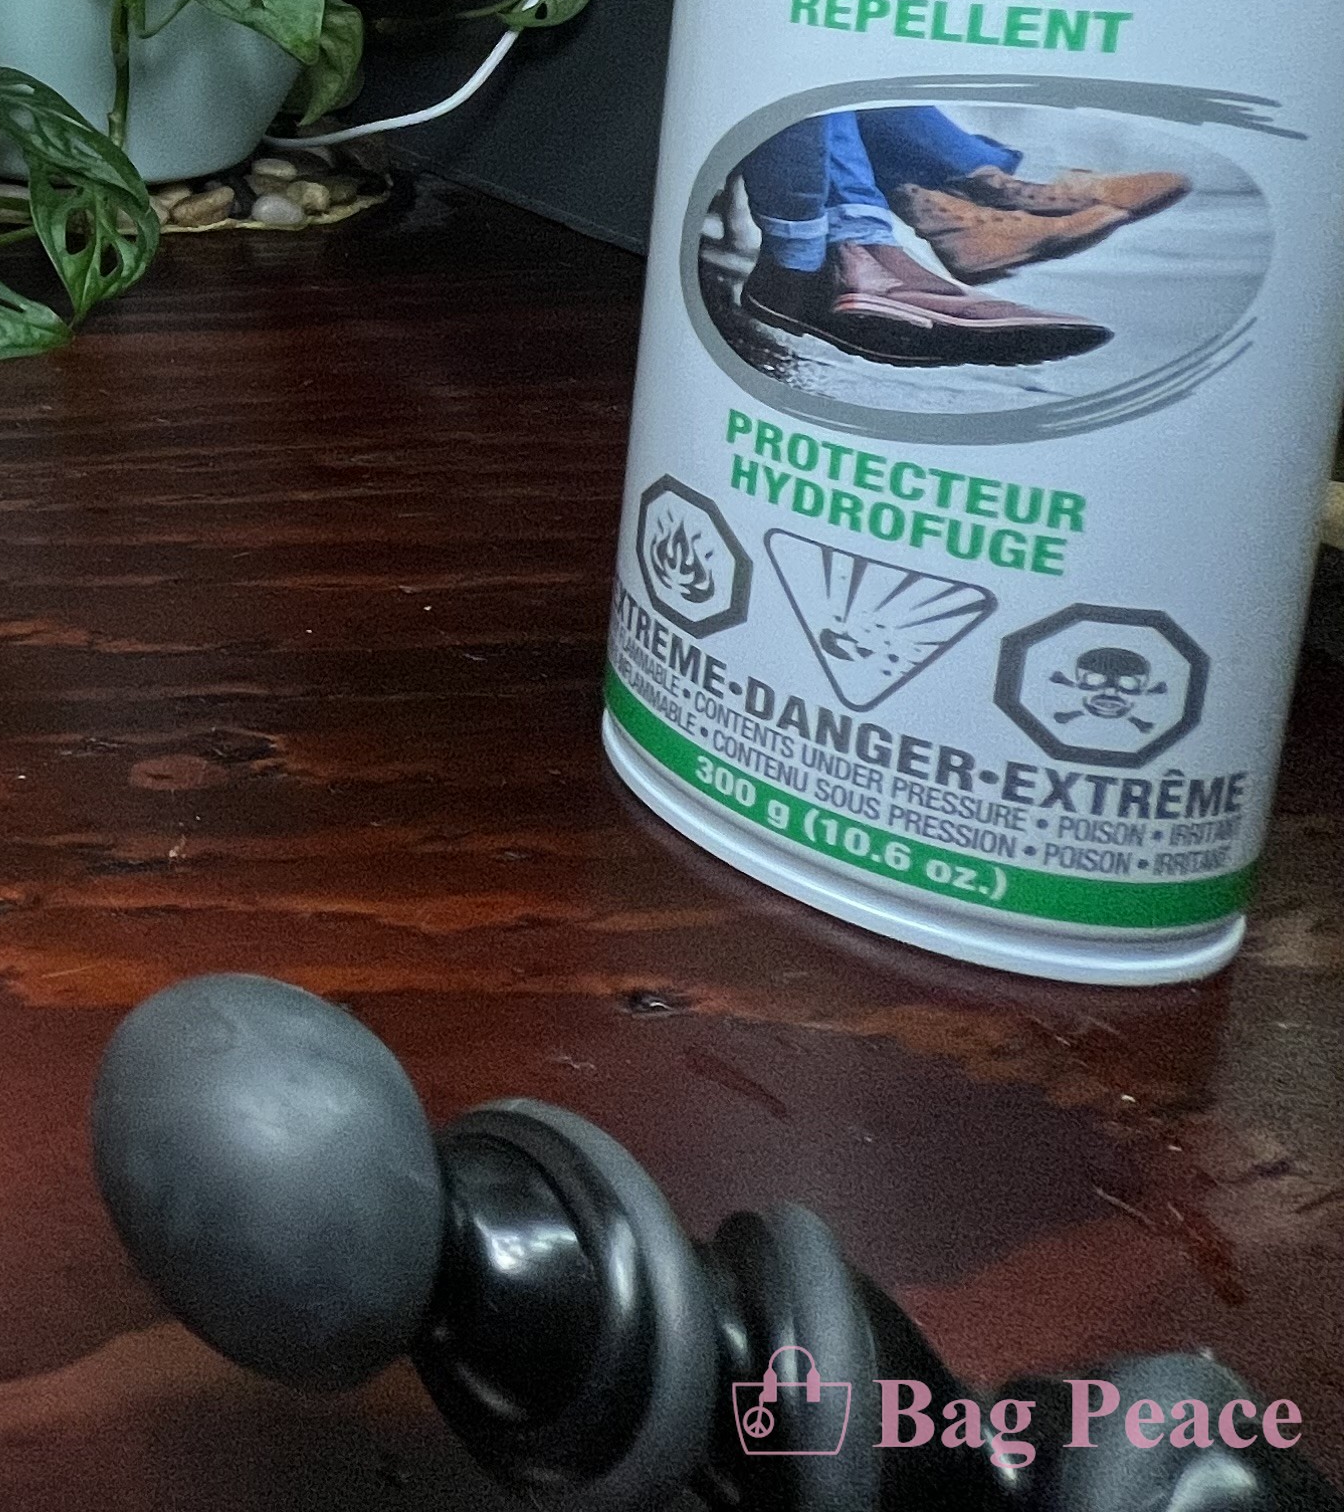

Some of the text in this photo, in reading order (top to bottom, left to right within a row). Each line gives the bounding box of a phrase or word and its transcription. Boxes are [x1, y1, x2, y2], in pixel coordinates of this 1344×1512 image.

[724, 408, 1087, 534] PROTECTEUR
[730, 454, 1068, 577] HYDROFUGE
[614, 586, 1248, 820] XTREME DANGER EXTRÊME
[694, 690, 795, 760] CONTENTS
[801, 742, 885, 795] UNDER
[890, 776, 1030, 833] PRESSURE
[1058, 815, 1146, 847] POISON
[694, 755, 1008, 901] 300 g (10.6 oz.)
[712, 729, 809, 794] CONTENU
[814, 777, 881, 821] SOUS
[887, 803, 1018, 859] PRESSION
[1043, 842, 1133, 875] POISON
